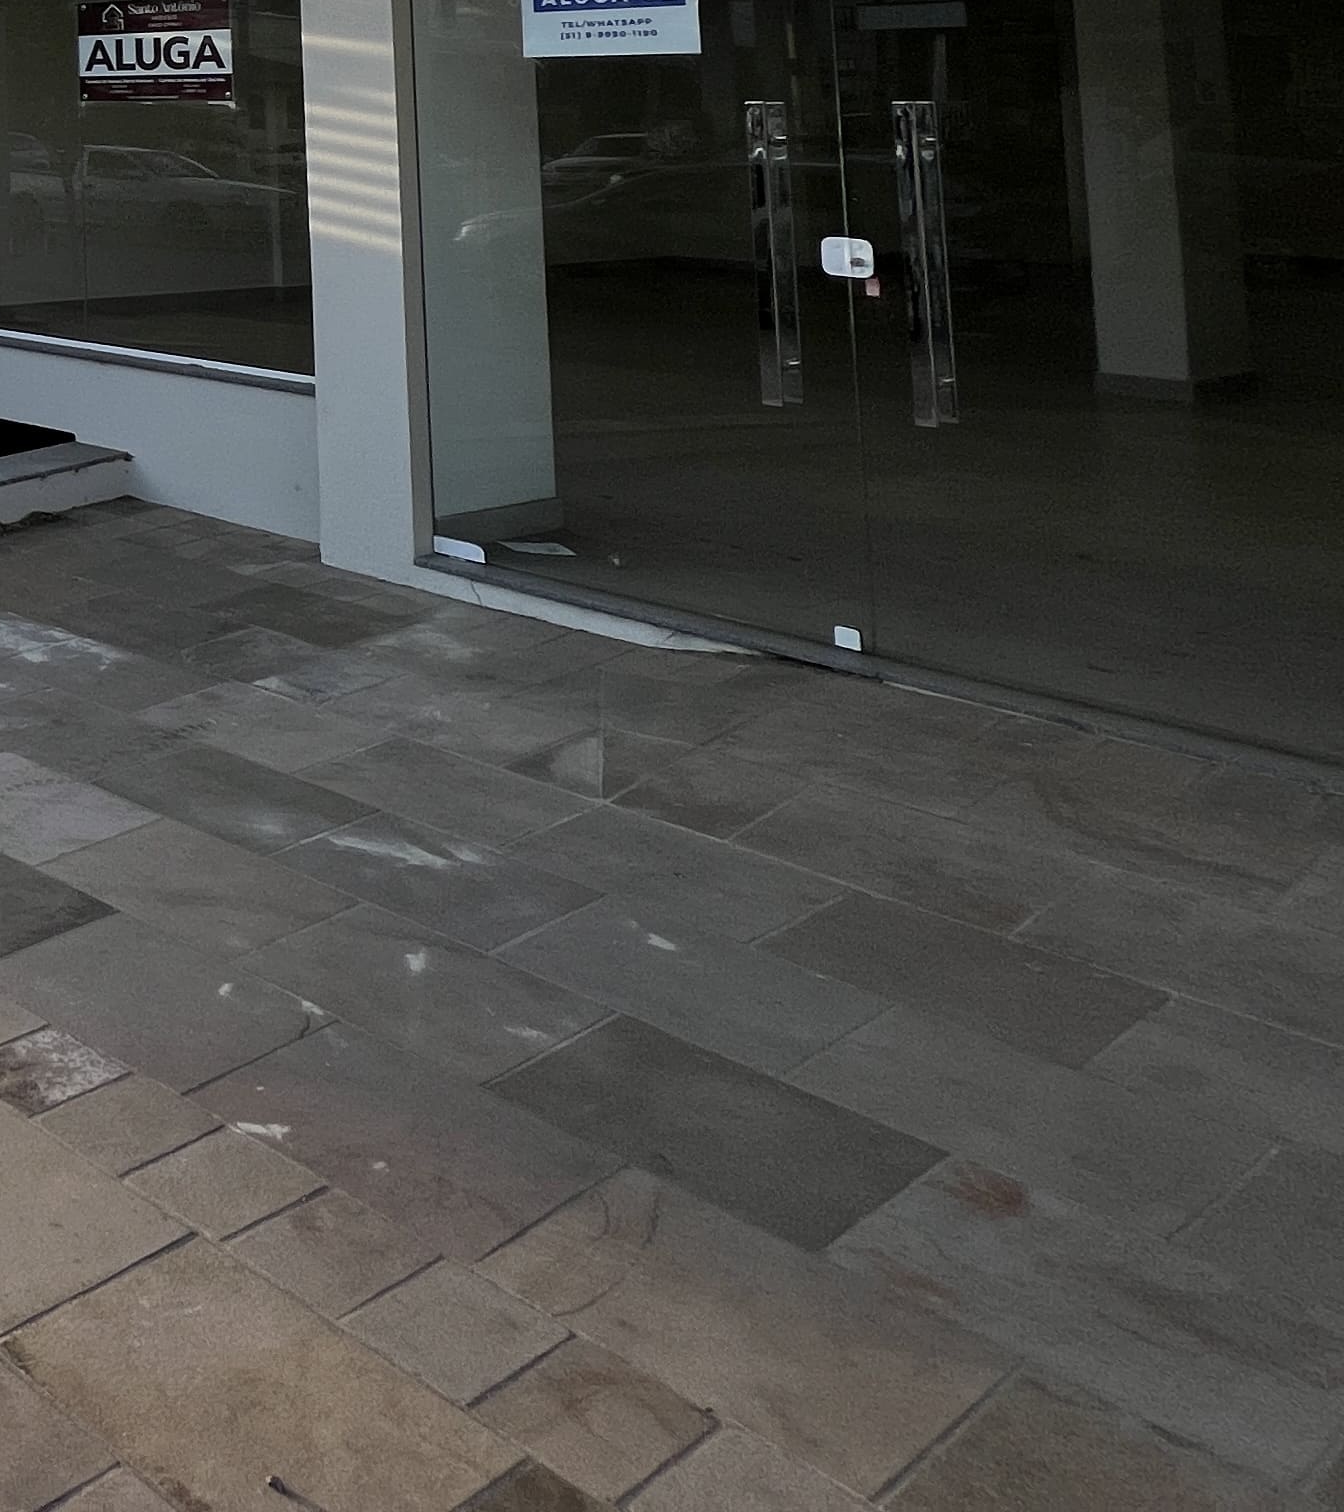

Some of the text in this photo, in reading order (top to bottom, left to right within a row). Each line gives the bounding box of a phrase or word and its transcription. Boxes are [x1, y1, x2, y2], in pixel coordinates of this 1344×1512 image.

[127, 3, 159, 15] Santo
[560, 17, 653, 29] TEL/WHATSAPP
[85, 35, 226, 72] ALUGA
